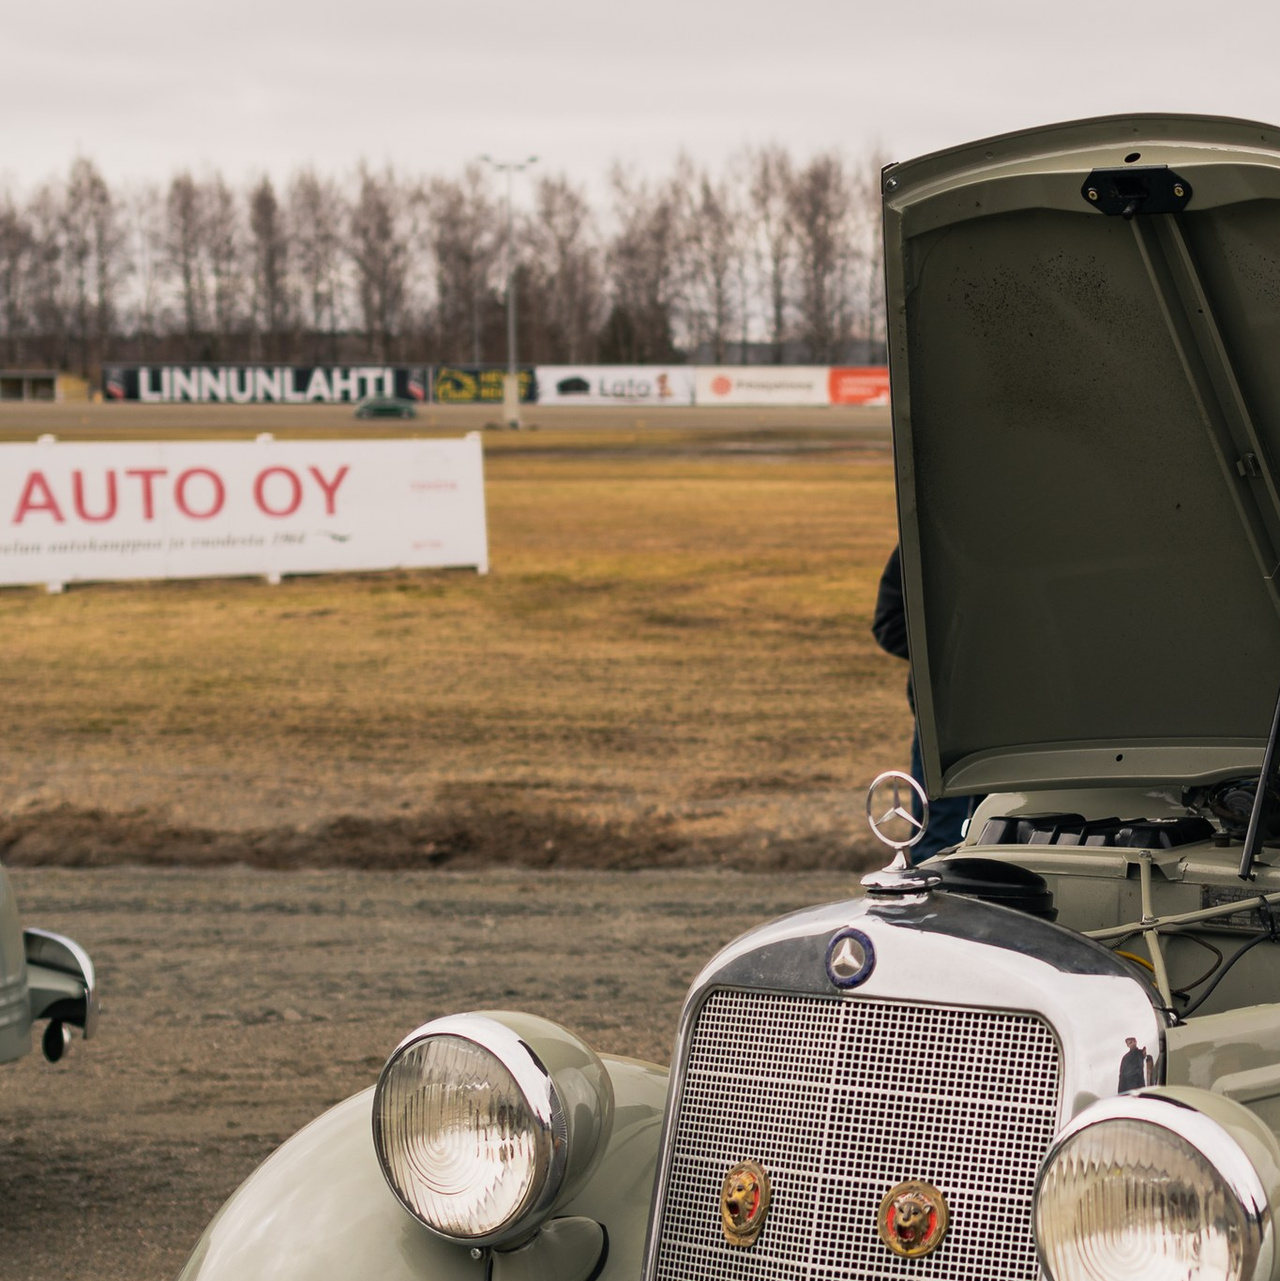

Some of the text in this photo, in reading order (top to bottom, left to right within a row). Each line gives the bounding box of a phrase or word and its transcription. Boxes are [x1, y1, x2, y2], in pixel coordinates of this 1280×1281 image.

[138, 366, 394, 403] LINNUNLAHTI
[11, 465, 350, 524] AUTO OY
